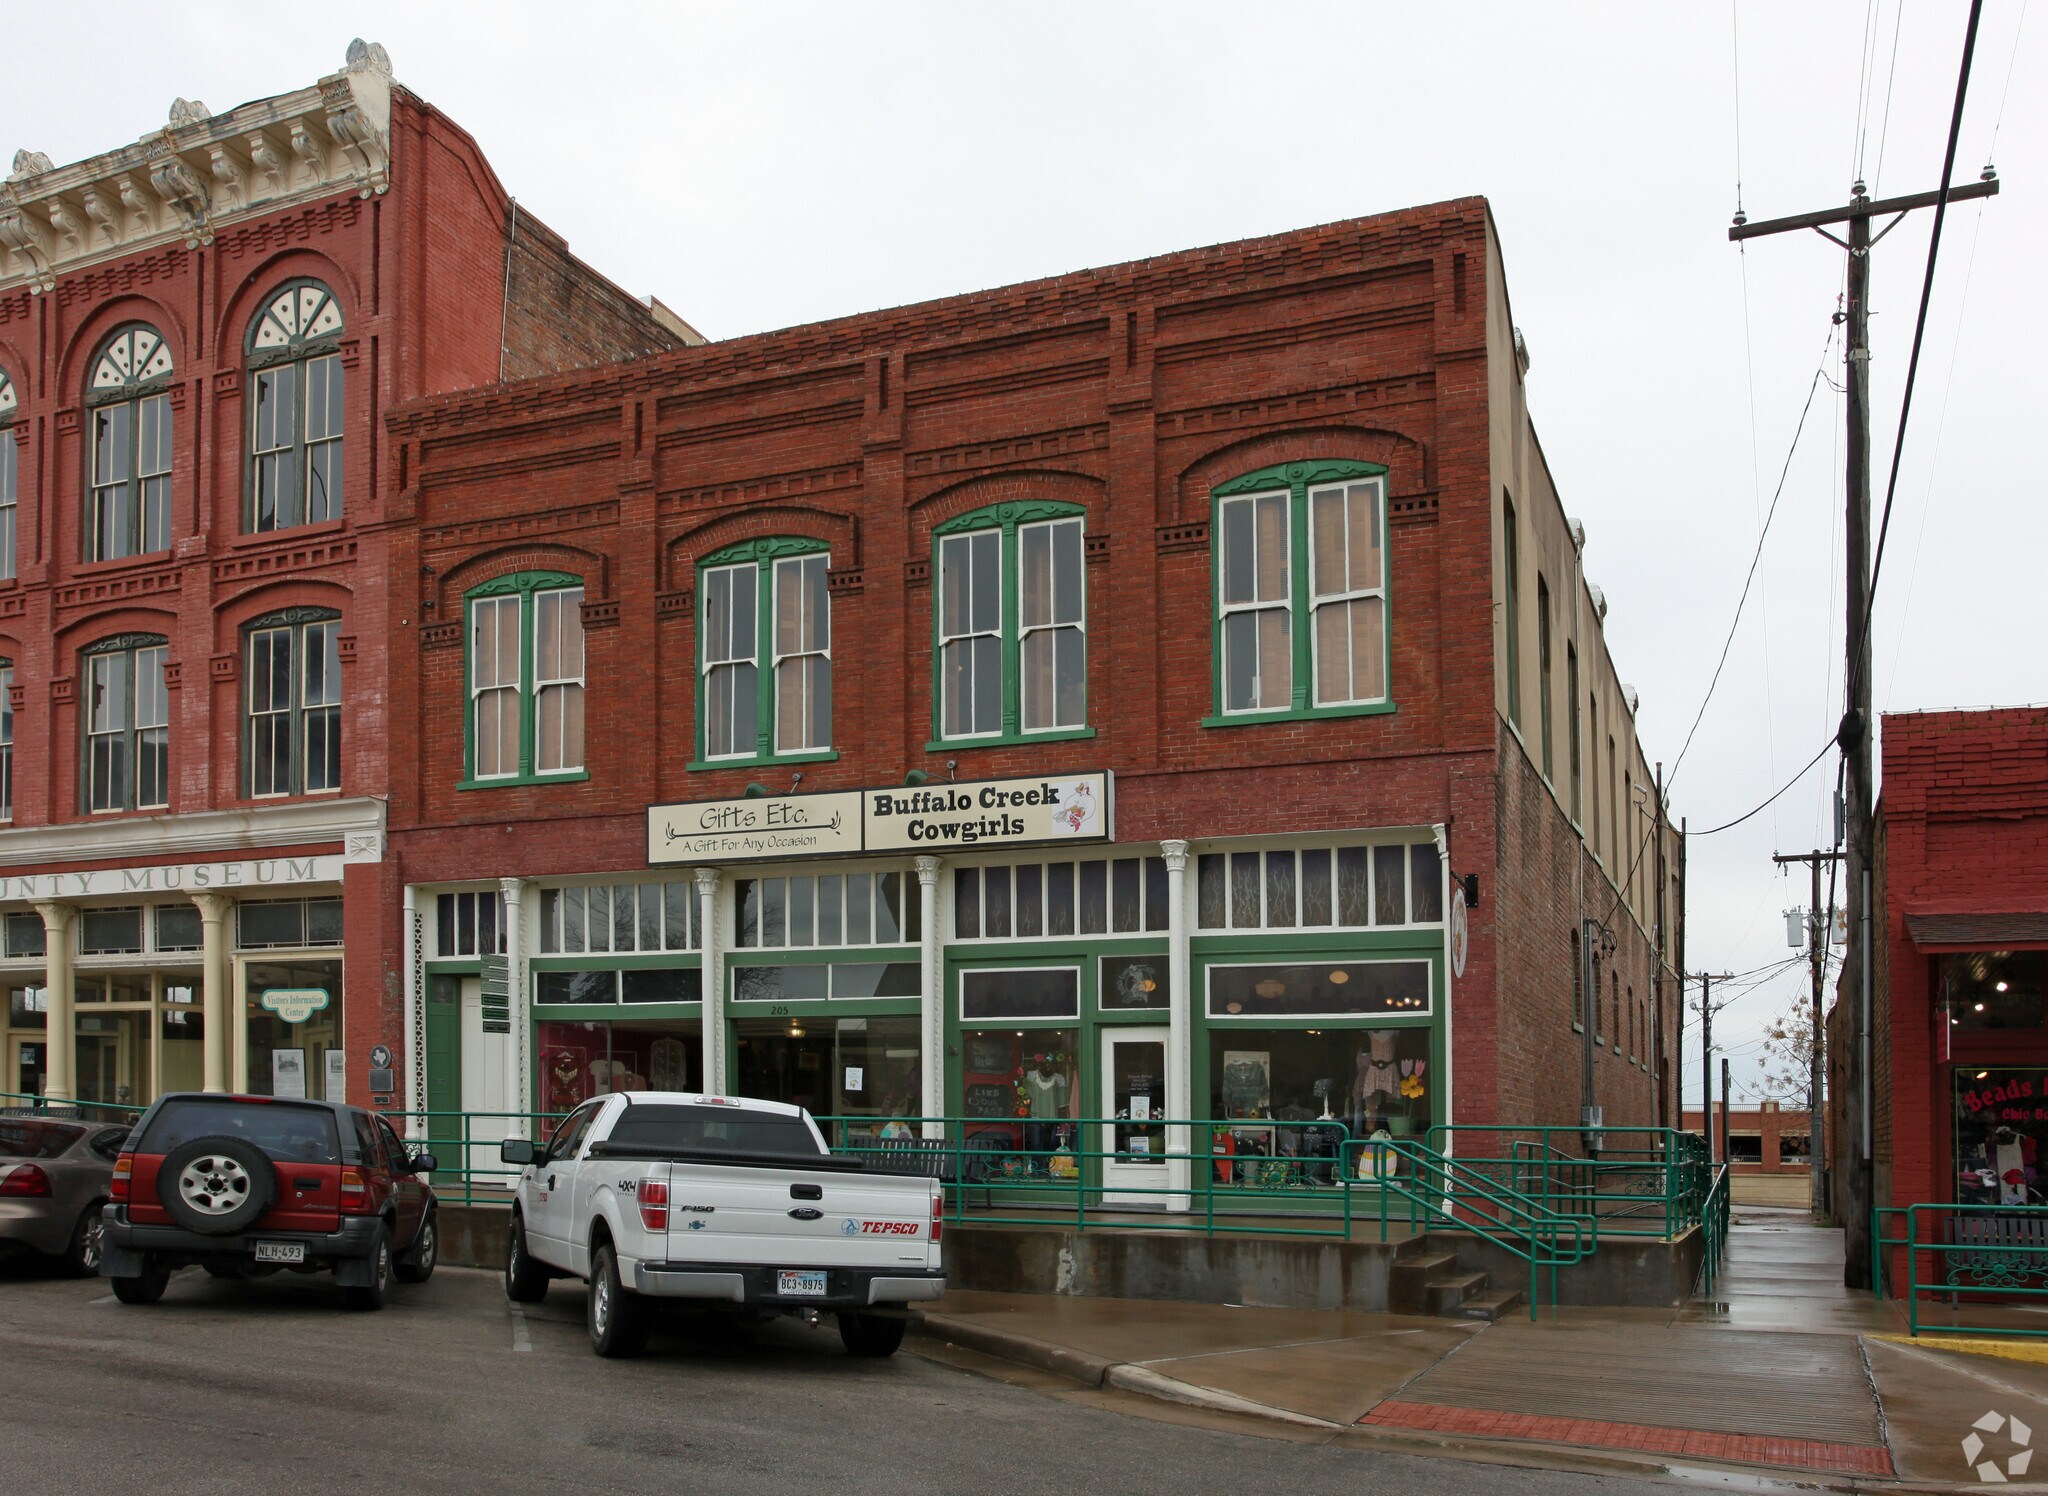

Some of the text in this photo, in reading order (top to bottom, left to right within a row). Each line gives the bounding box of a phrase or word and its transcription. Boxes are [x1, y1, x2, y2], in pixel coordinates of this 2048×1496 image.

[873, 783, 1060, 817] Buffalo Creek
[699, 803, 808, 829] Gifts Etc.
[907, 814, 1025, 842] Cowgirls
[682, 835, 817, 852] A Gift For Any Occasion
[121, 858, 317, 892] MUSEUM
[267, 995, 324, 1005] Visitors Information
[285, 1008, 304, 1017] Center
[771, 1006, 788, 1015] 205
[1965, 1079, 2033, 1112] Beads
[2002, 1108, 2030, 1119] Chic
[796, 1208, 816, 1218] Ford
[862, 1221, 919, 1235] TEPSCO
